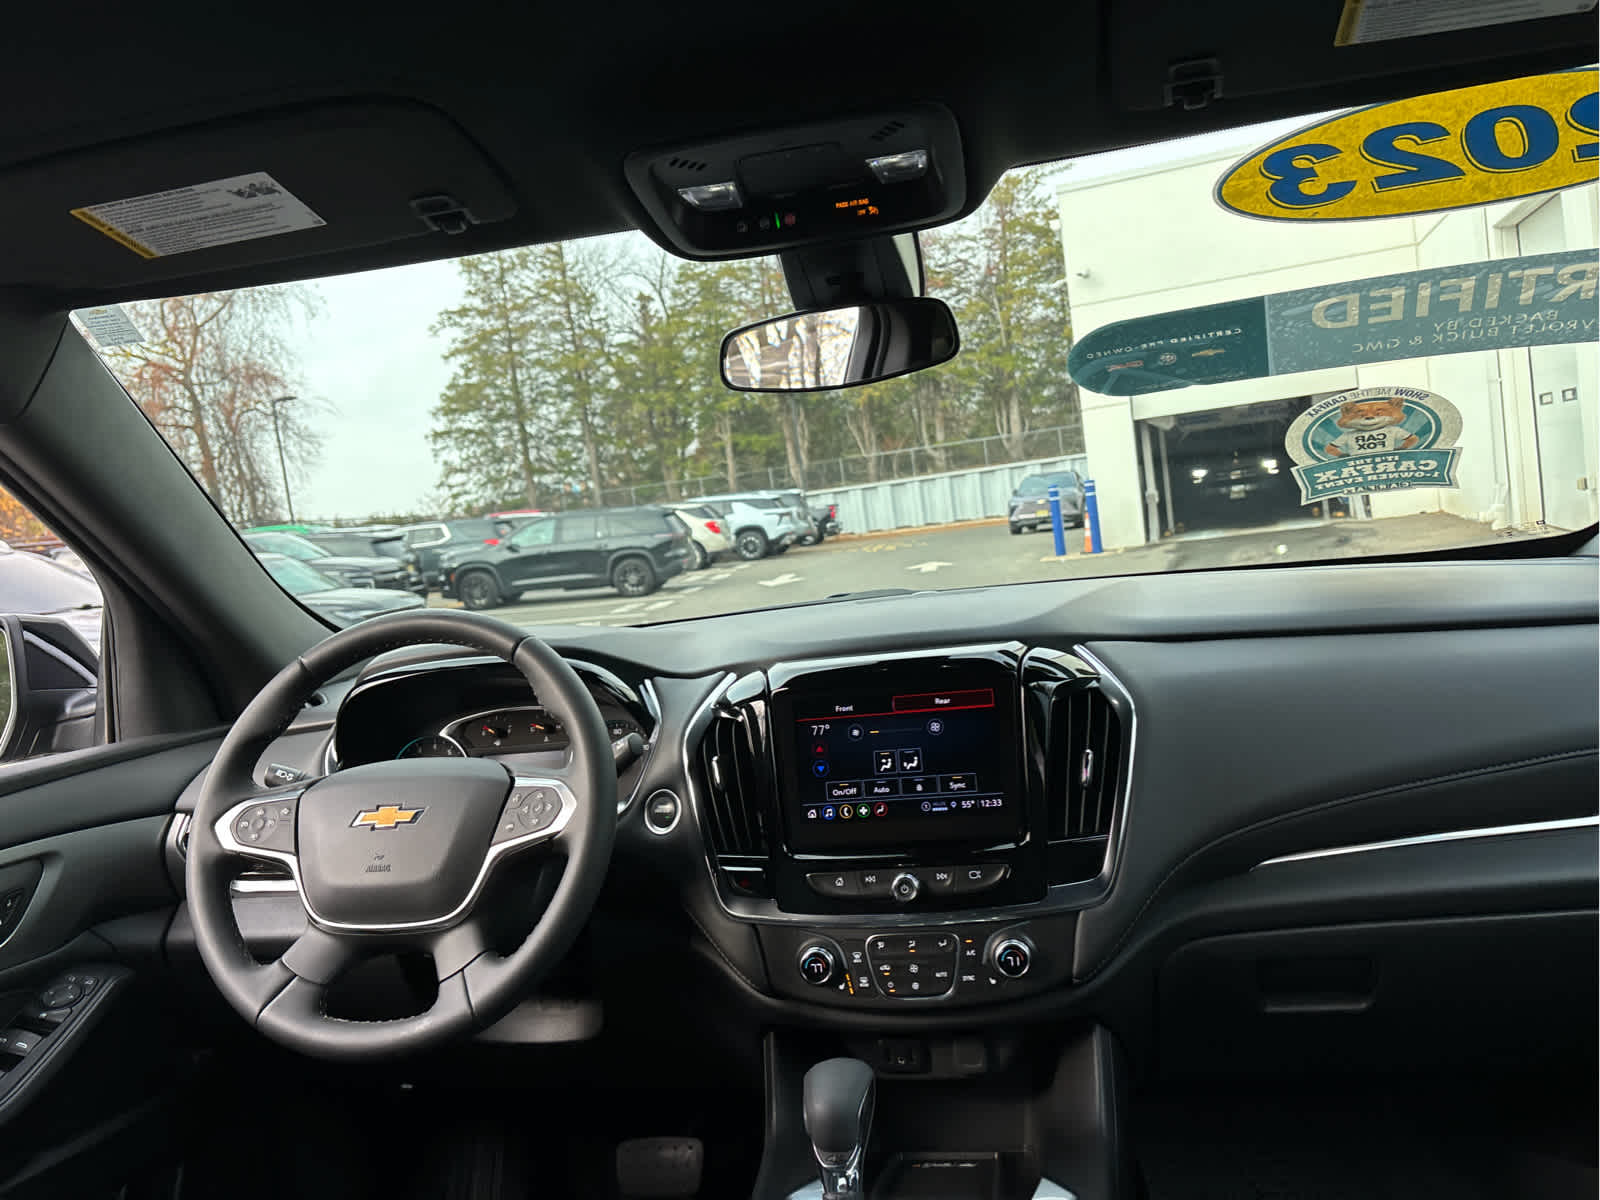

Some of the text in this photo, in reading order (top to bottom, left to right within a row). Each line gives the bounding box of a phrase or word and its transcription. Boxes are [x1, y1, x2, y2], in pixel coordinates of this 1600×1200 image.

[835, 704, 854, 712] Front
[873, 786, 890, 794] Auto
[949, 781, 967, 791] Sync
[832, 786, 857, 796] On/Off
[981, 799, 1002, 808] 12:33
